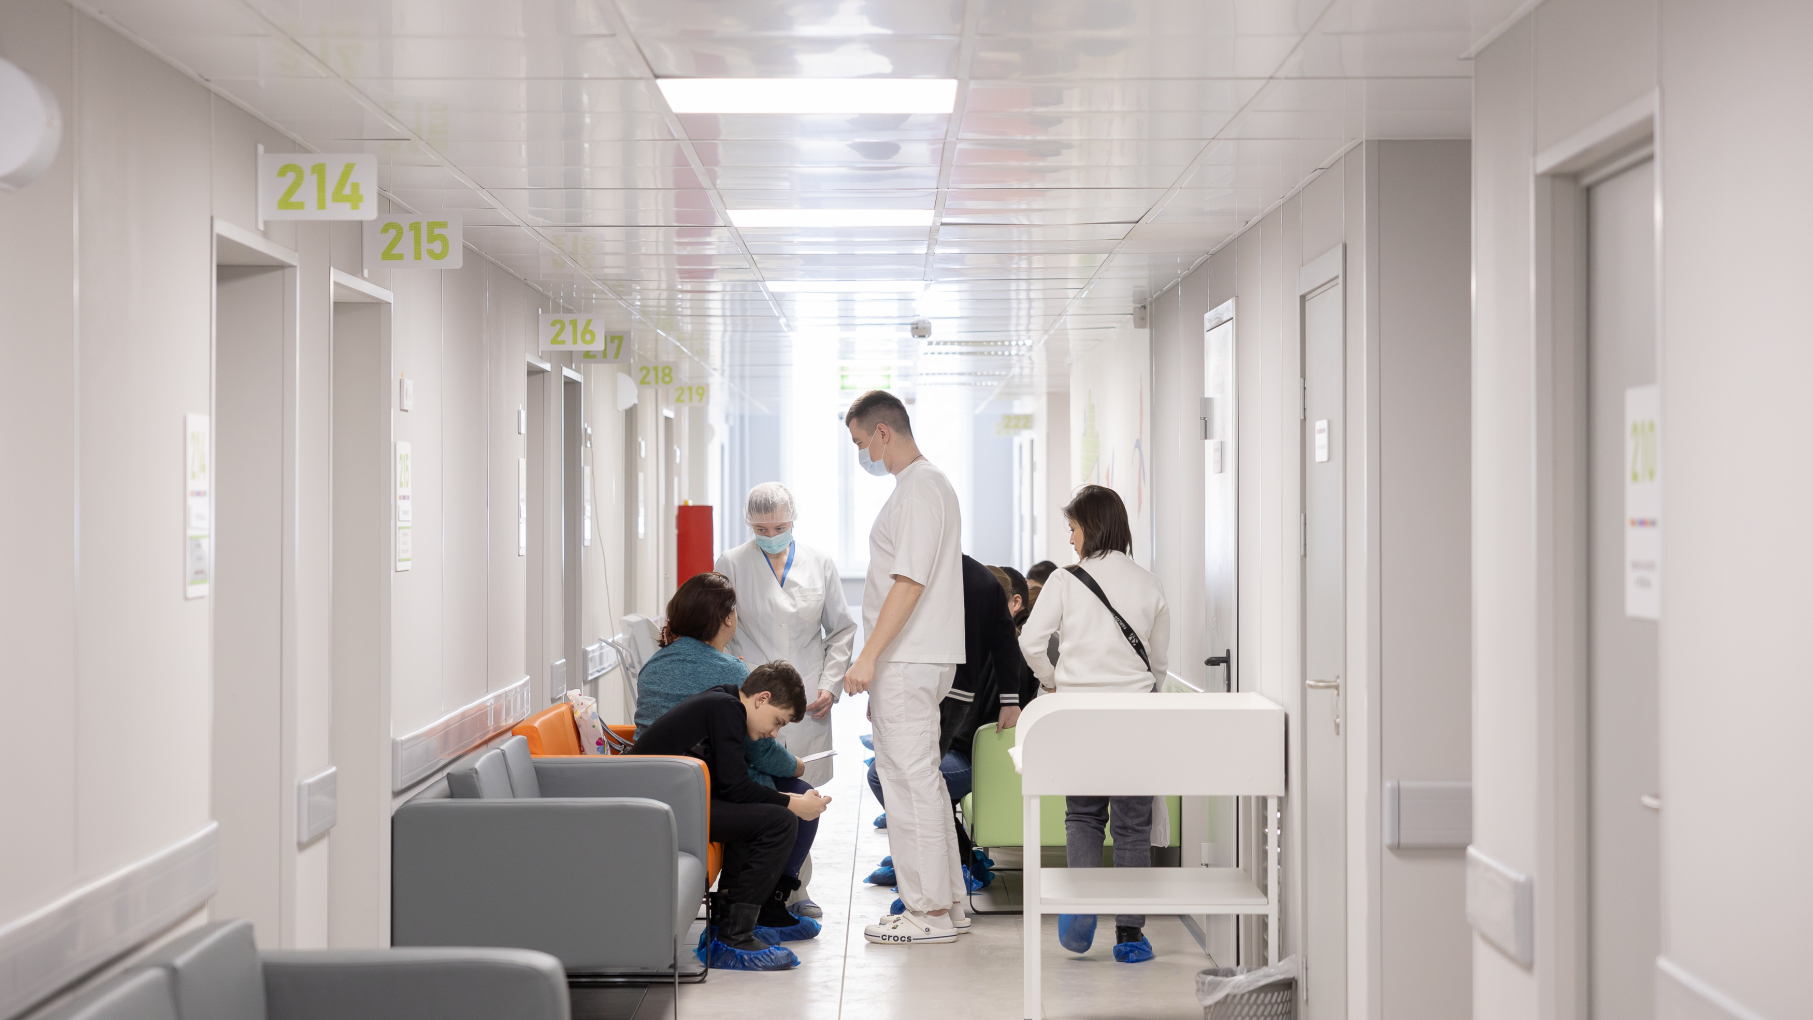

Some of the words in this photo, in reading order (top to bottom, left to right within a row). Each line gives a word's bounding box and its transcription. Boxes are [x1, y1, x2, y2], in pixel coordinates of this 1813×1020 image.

[276, 162, 364, 211] 214
[380, 221, 450, 261] 215
[550, 318, 597, 345] 216
[638, 365, 674, 386] 218
[675, 386, 706, 404] 219
[399, 453, 409, 488] 215
[881, 934, 912, 943] crocs
